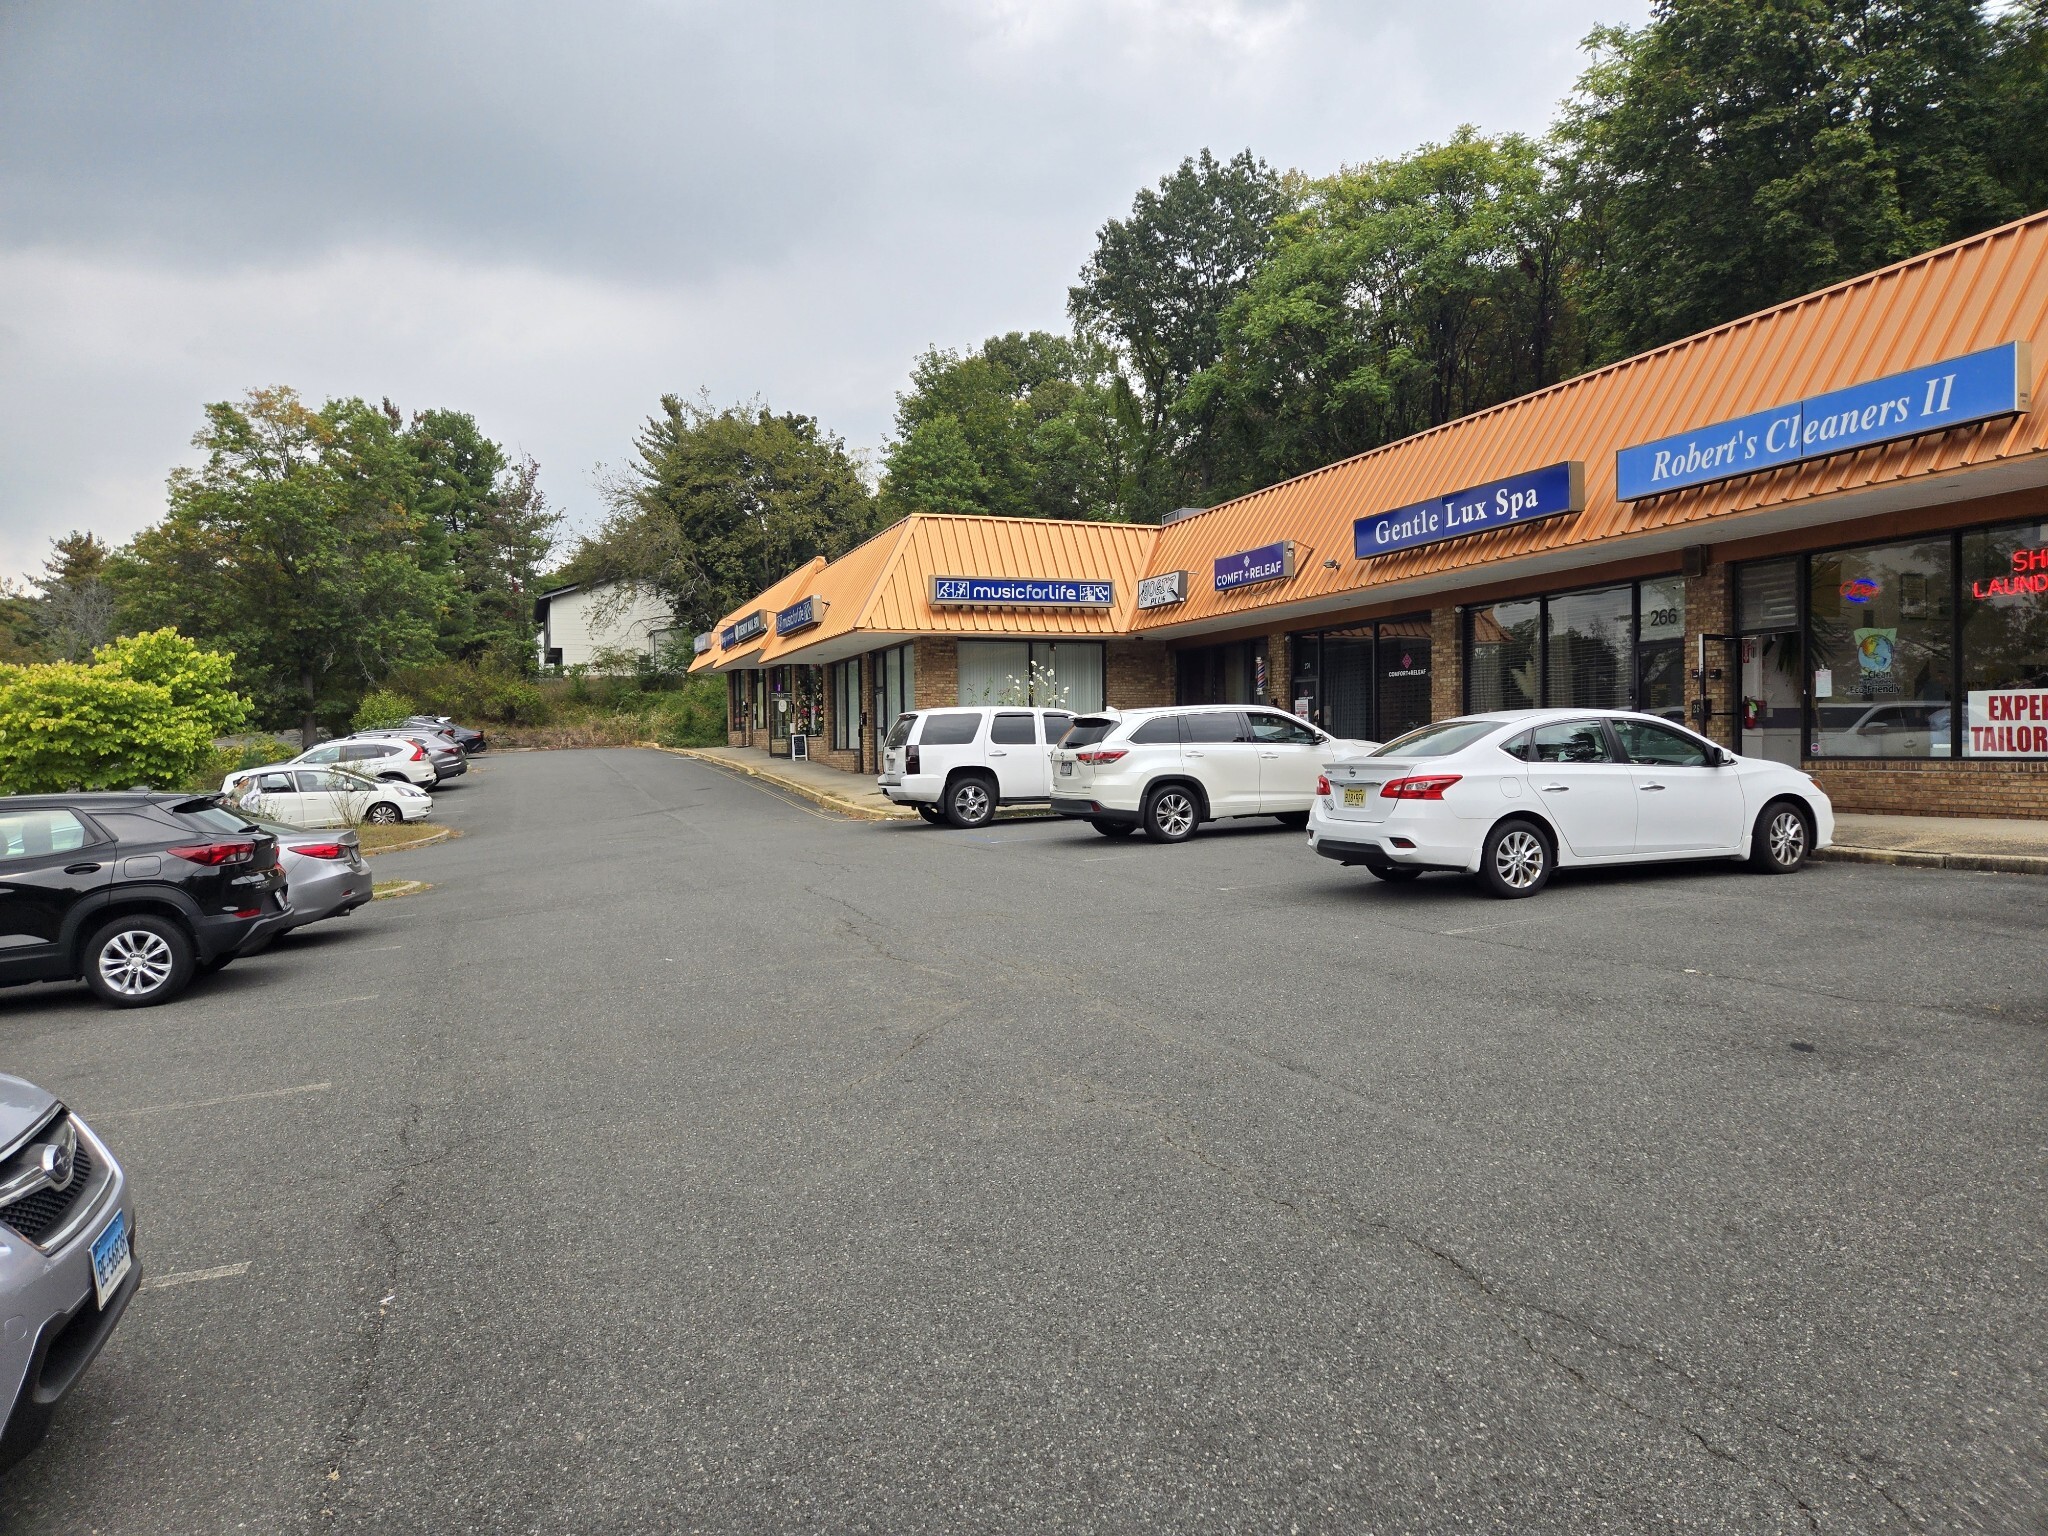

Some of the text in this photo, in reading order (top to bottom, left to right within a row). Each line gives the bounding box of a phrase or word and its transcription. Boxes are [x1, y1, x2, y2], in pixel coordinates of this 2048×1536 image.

[1651, 374, 1957, 483] Robert's Cleaners II
[1375, 488, 1538, 545] Gentle Lux Spa
[1216, 570, 1243, 587] COMFT
[1250, 561, 1282, 579] RELEAF
[973, 583, 1077, 600] musicforlife
[1150, 595, 1166, 605] PLUS
[1650, 608, 1677, 627] 266
[1868, 671, 1892, 679] Clean
[1970, 725, 2048, 753] TAILOR
